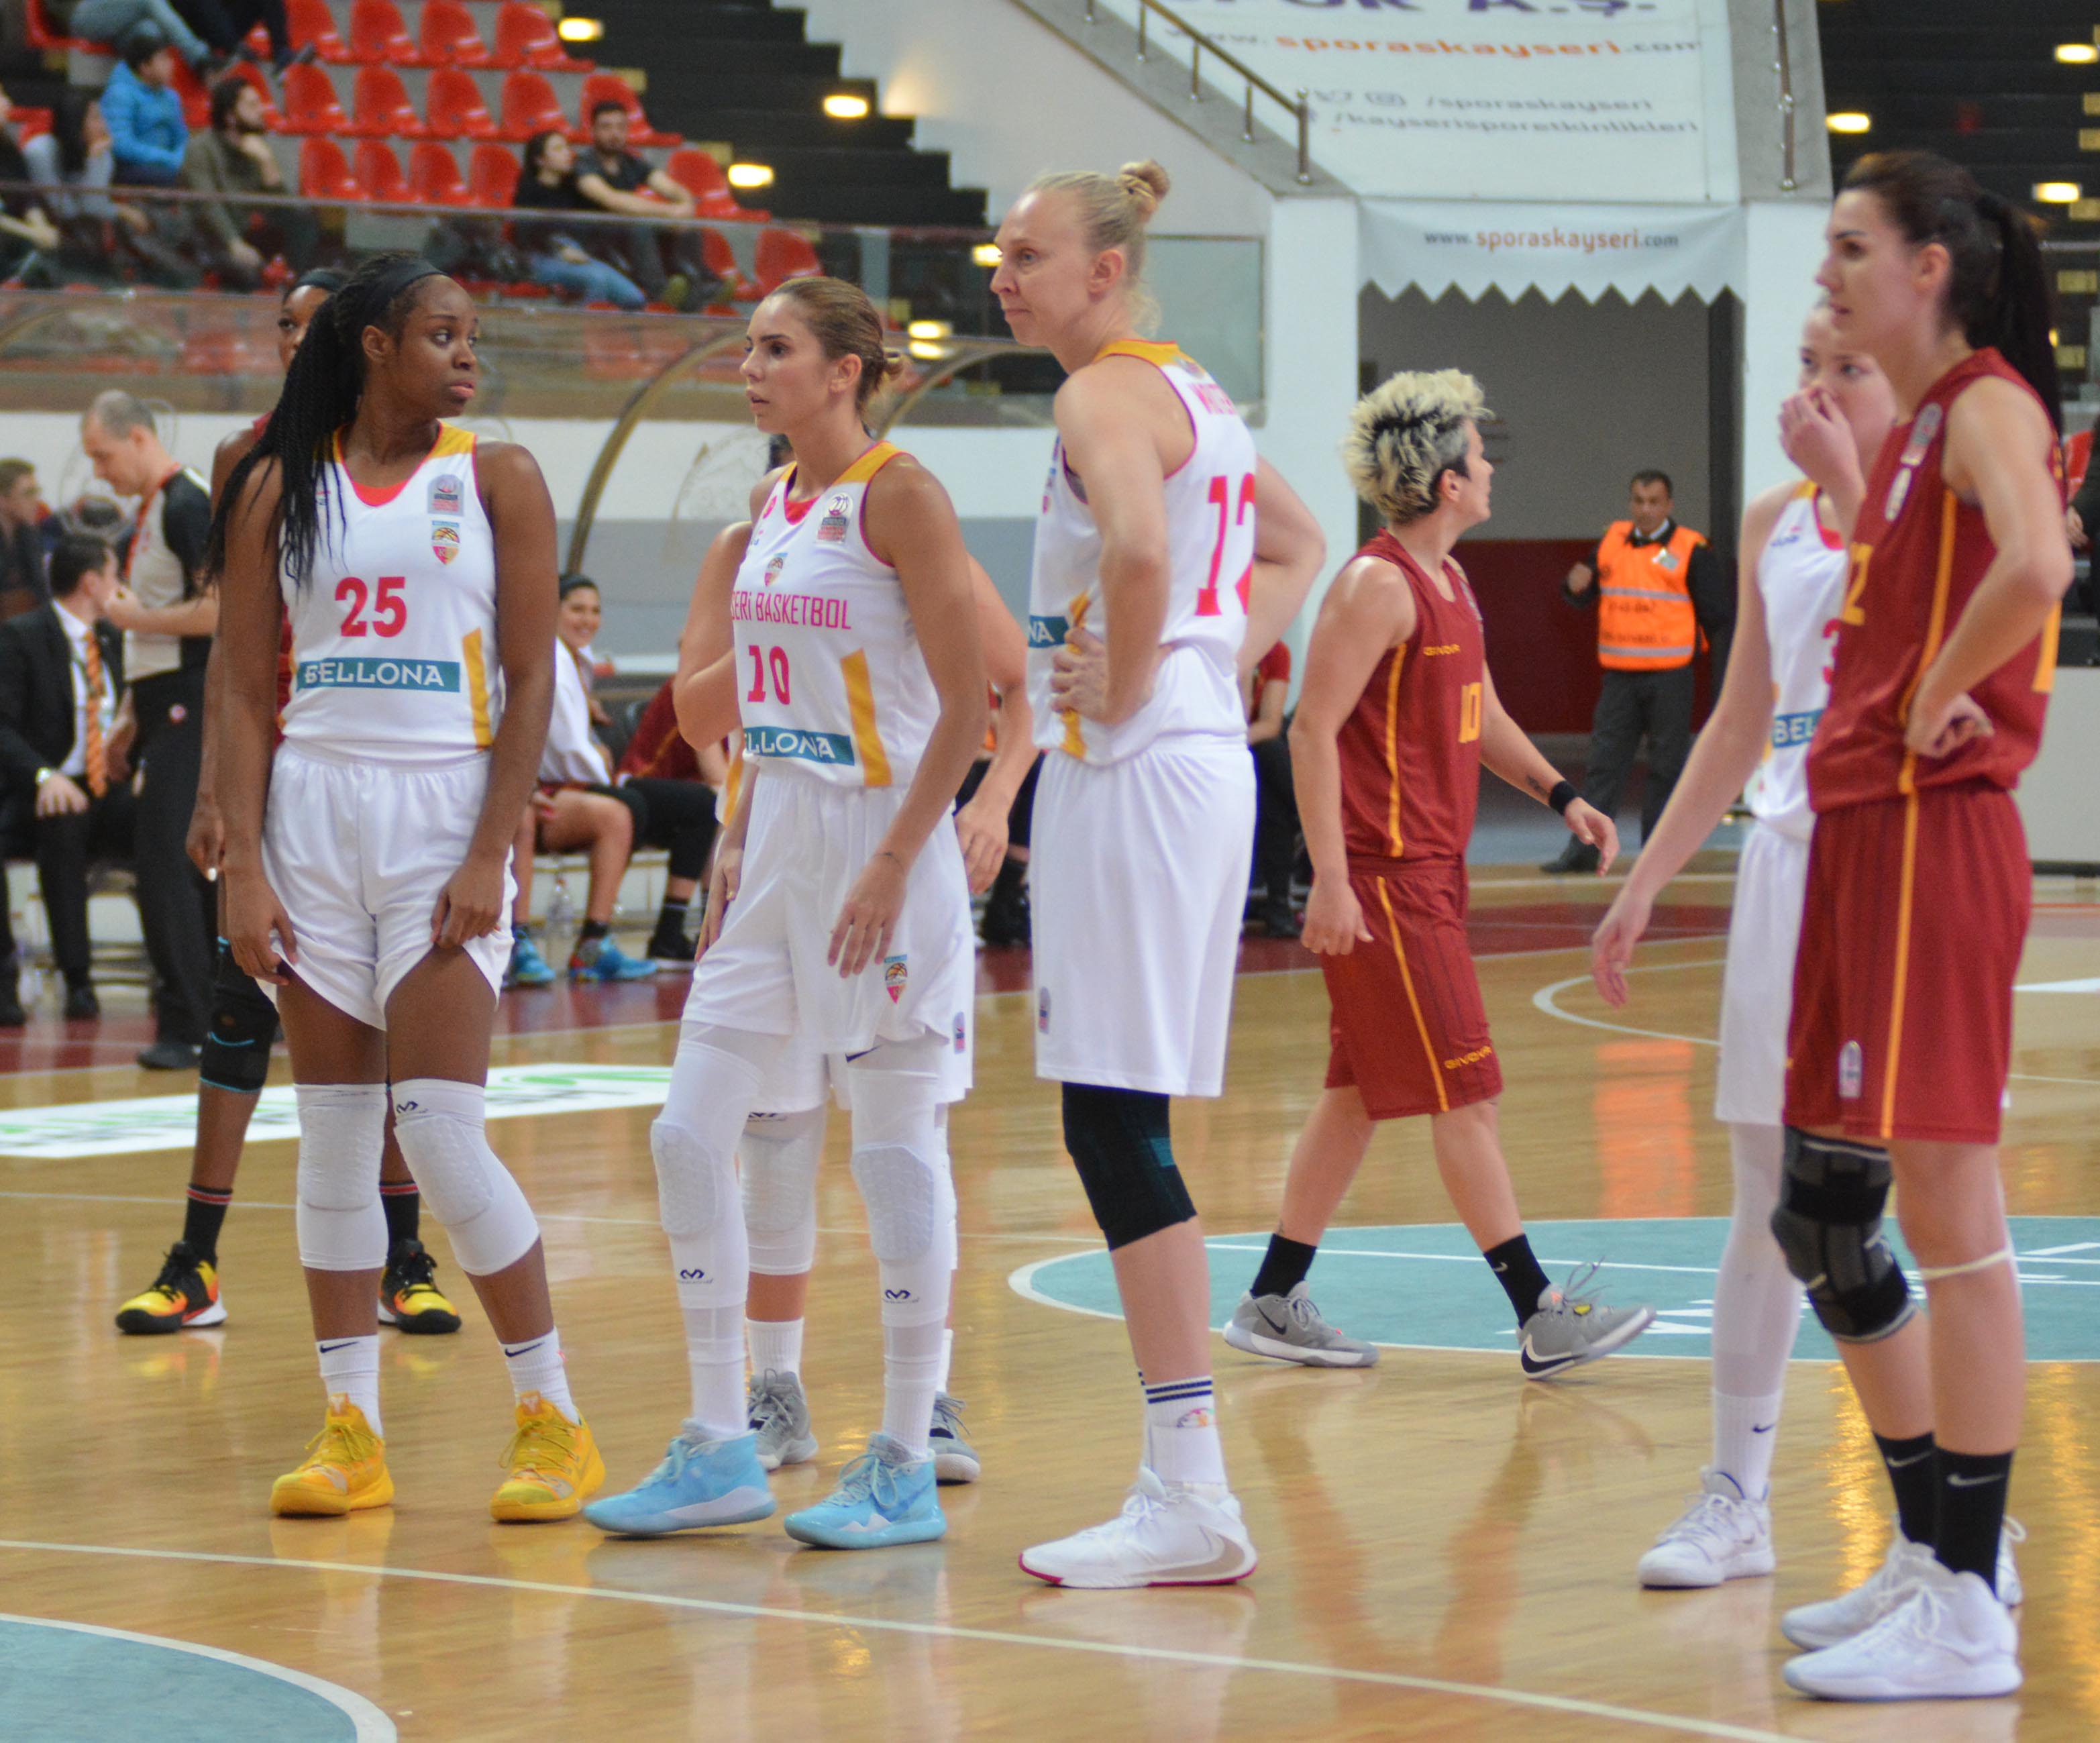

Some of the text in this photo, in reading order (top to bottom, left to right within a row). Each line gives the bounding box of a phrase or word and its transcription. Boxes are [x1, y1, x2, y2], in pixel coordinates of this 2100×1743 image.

[1423, 227, 1679, 254] www.sporaskayseri.com
[335, 576, 407, 637] 25
[755, 592, 851, 630] BASKETBOL
[304, 662, 445, 686] BELLONA
[746, 644, 791, 705] 10
